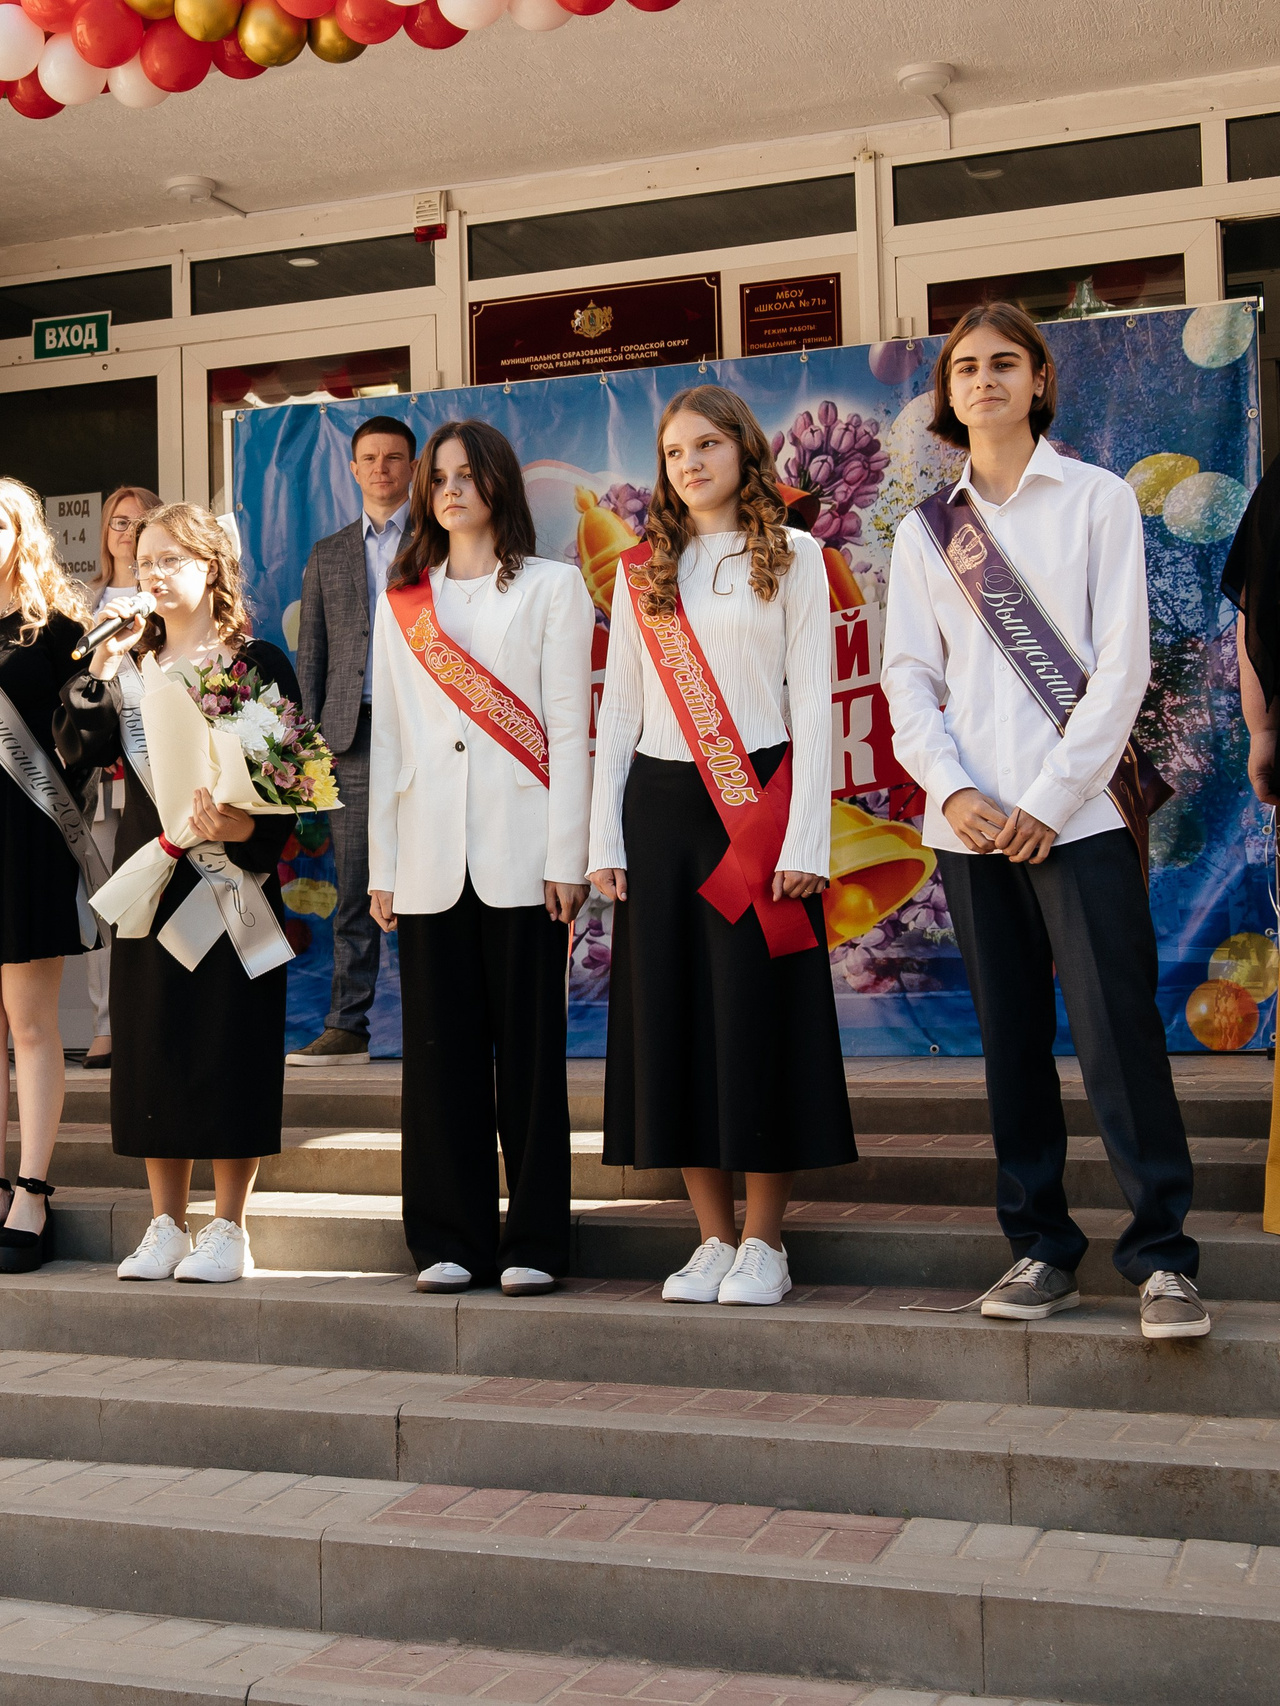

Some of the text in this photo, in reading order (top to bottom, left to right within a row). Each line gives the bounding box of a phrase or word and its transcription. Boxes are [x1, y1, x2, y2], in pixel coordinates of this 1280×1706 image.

[775, 289, 804, 300] МБОУ
[754, 301, 796, 313] «ШКОЛА
[45, 323, 98, 350] ВХОД
[764, 327, 788, 335] РЕЖИМ
[500, 352, 561, 366] МУНИЦИПАЛЬНОЕ
[562, 347, 612, 359] ОБРАЗОВАНИЕ
[620, 340, 665, 353] ГОРОДСКОЙ
[666, 338, 689, 348] ОКРУГ
[750, 340, 797, 350] ПОНЕДЕЛЬНИК
[530, 350, 659, 371] ГОРОД РЯЗАНЬ РЯЗАНСКОЙ ОБЛАСТИ
[58, 499, 90, 518] ВХОД
[62, 529, 69, 545] 1
[79, 528, 86, 544] 4
[698, 736, 759, 806] 2025
[51, 802, 84, 844] 2025
